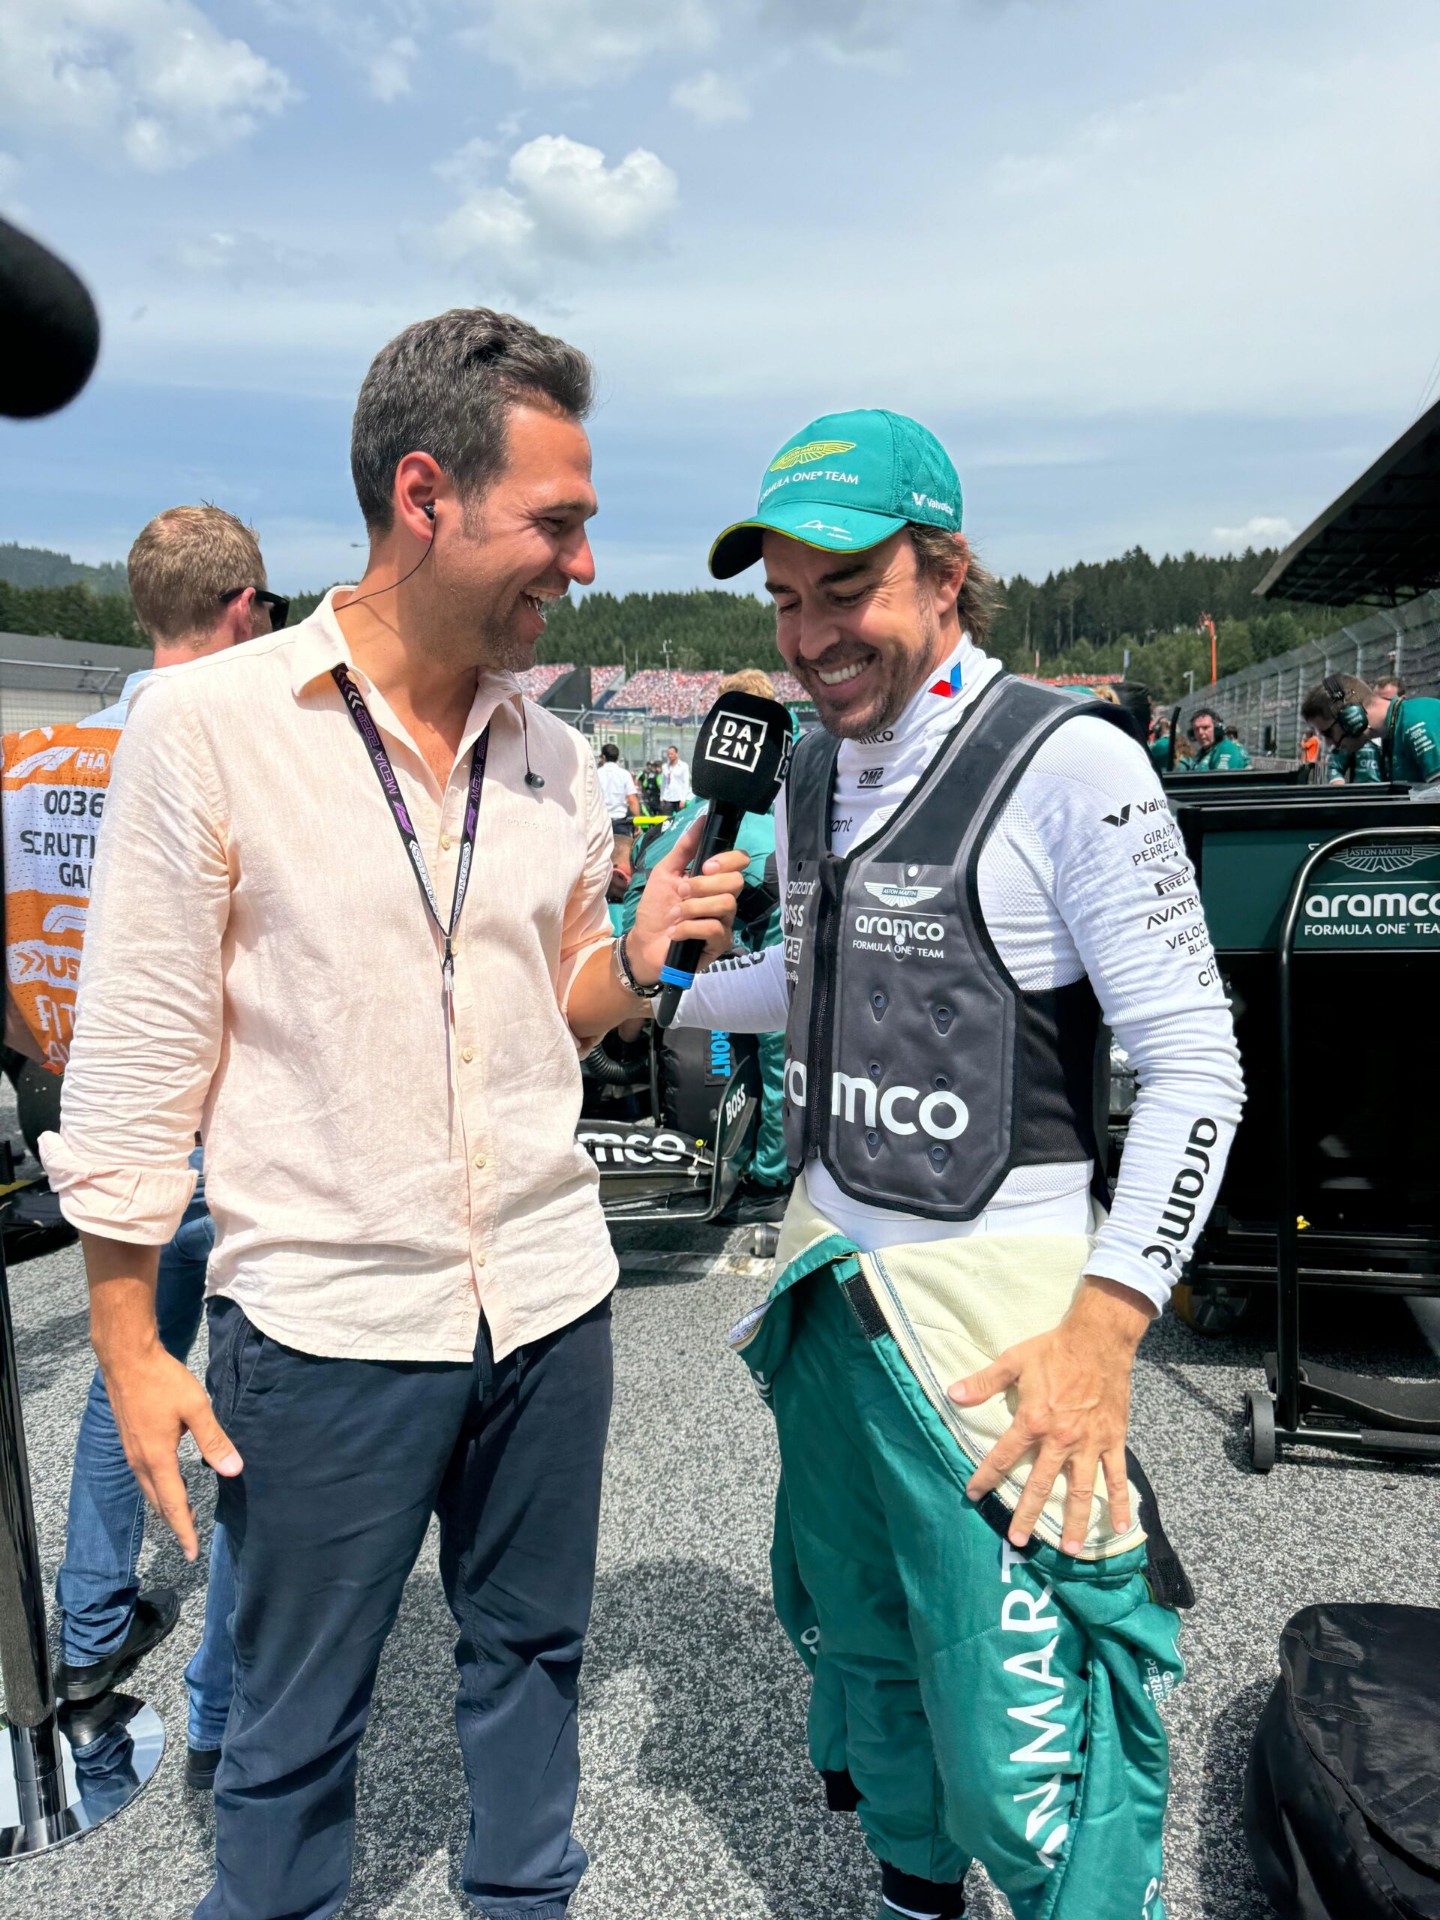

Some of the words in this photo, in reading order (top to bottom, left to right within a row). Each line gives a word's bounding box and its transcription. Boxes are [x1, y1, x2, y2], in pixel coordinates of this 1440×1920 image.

[825, 471, 859, 485] TEAM
[374, 751, 399, 794] MEDIA
[858, 769, 884, 785] OMP
[43, 789, 106, 818] 0036
[1349, 848, 1377, 857] ASTON
[1379, 847, 1411, 856] MARTIN
[855, 914, 945, 942] aramco
[1304, 923, 1373, 936] FORMULA
[852, 939, 892, 953] FORMULA
[916, 948, 945, 959] TEAM
[725, 1083, 746, 1127] BOSS
